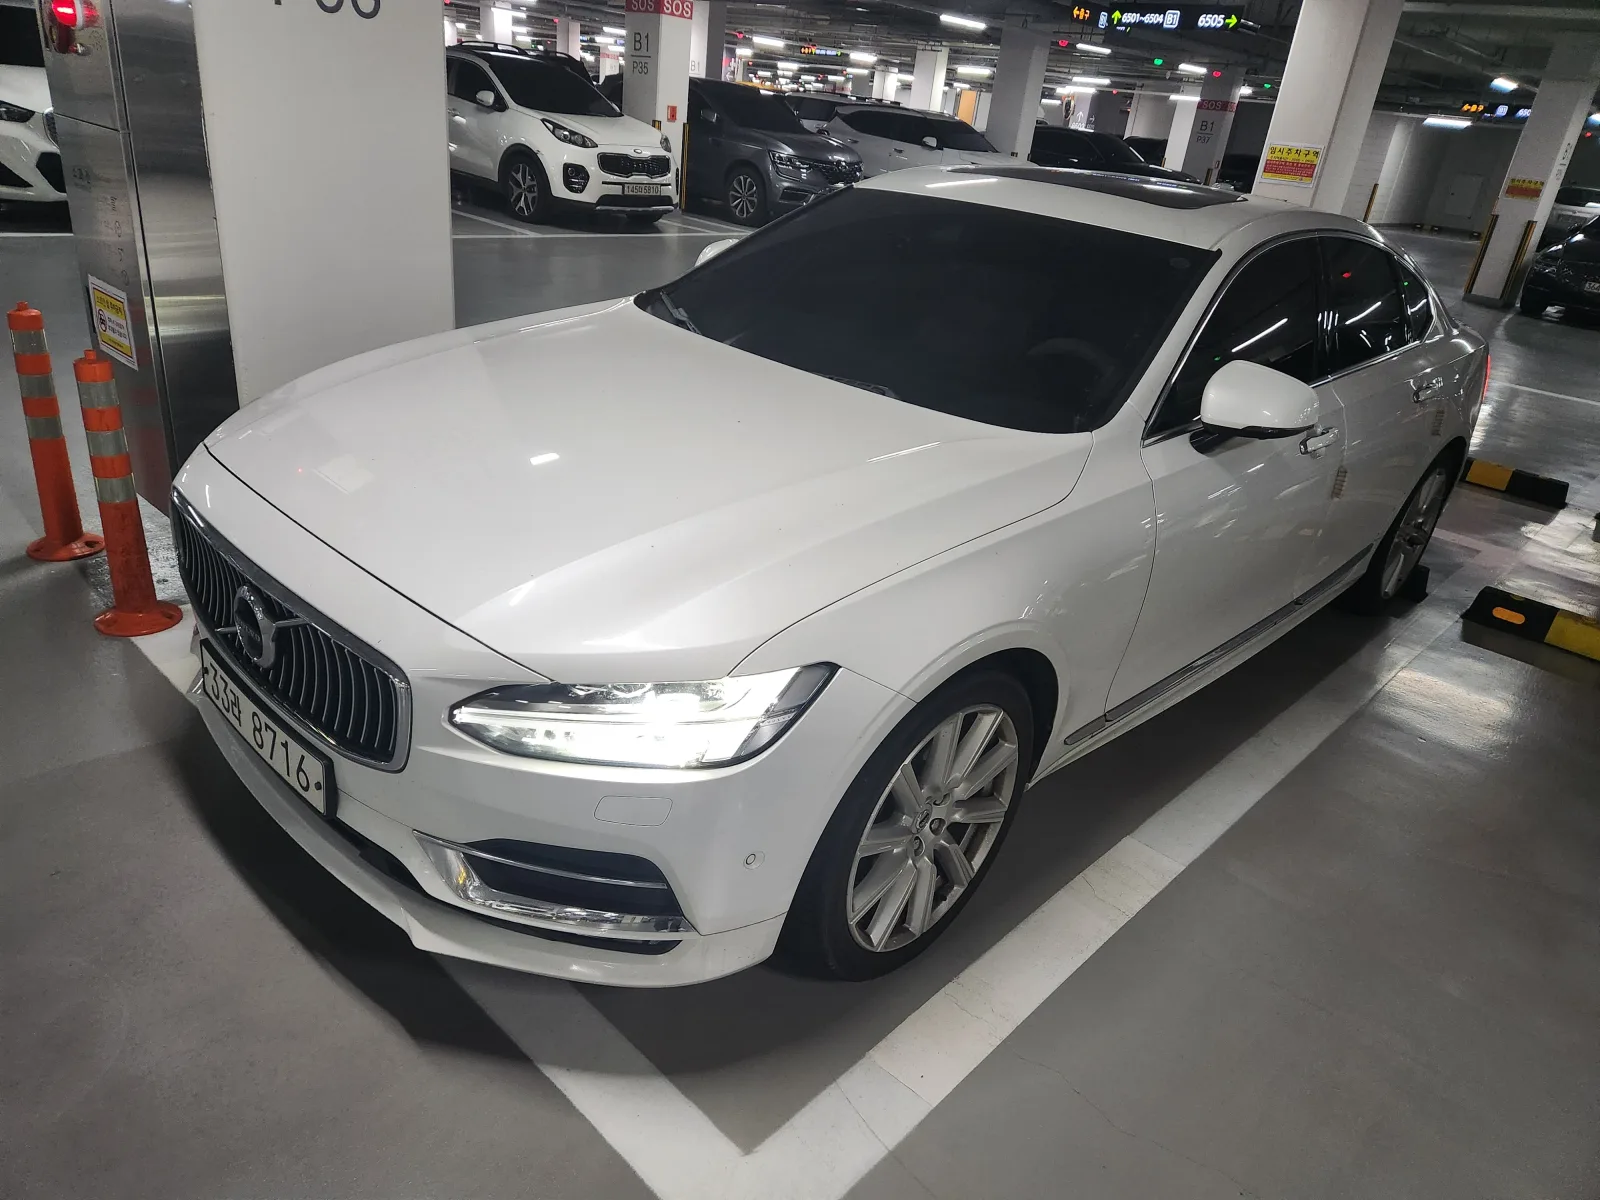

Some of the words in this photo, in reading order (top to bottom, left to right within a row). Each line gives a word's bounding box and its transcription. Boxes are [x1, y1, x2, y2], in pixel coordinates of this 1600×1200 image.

[631, 0, 655, 11] SOS
[663, 0, 691, 18] SOS
[1121, 12, 1164, 25] 6501~6504
[1198, 13, 1225, 28] 6505
[633, 32, 649, 53] B1
[632, 60, 649, 75] P35
[690, 60, 701, 72] B1
[1202, 100, 1222, 110] SOS
[1200, 120, 1215, 132] B1
[1196, 135, 1211, 144] P37
[1270, 146, 1320, 159] 임시주차구역
[210, 662, 242, 727] 33라
[251, 711, 310, 792] 8716
